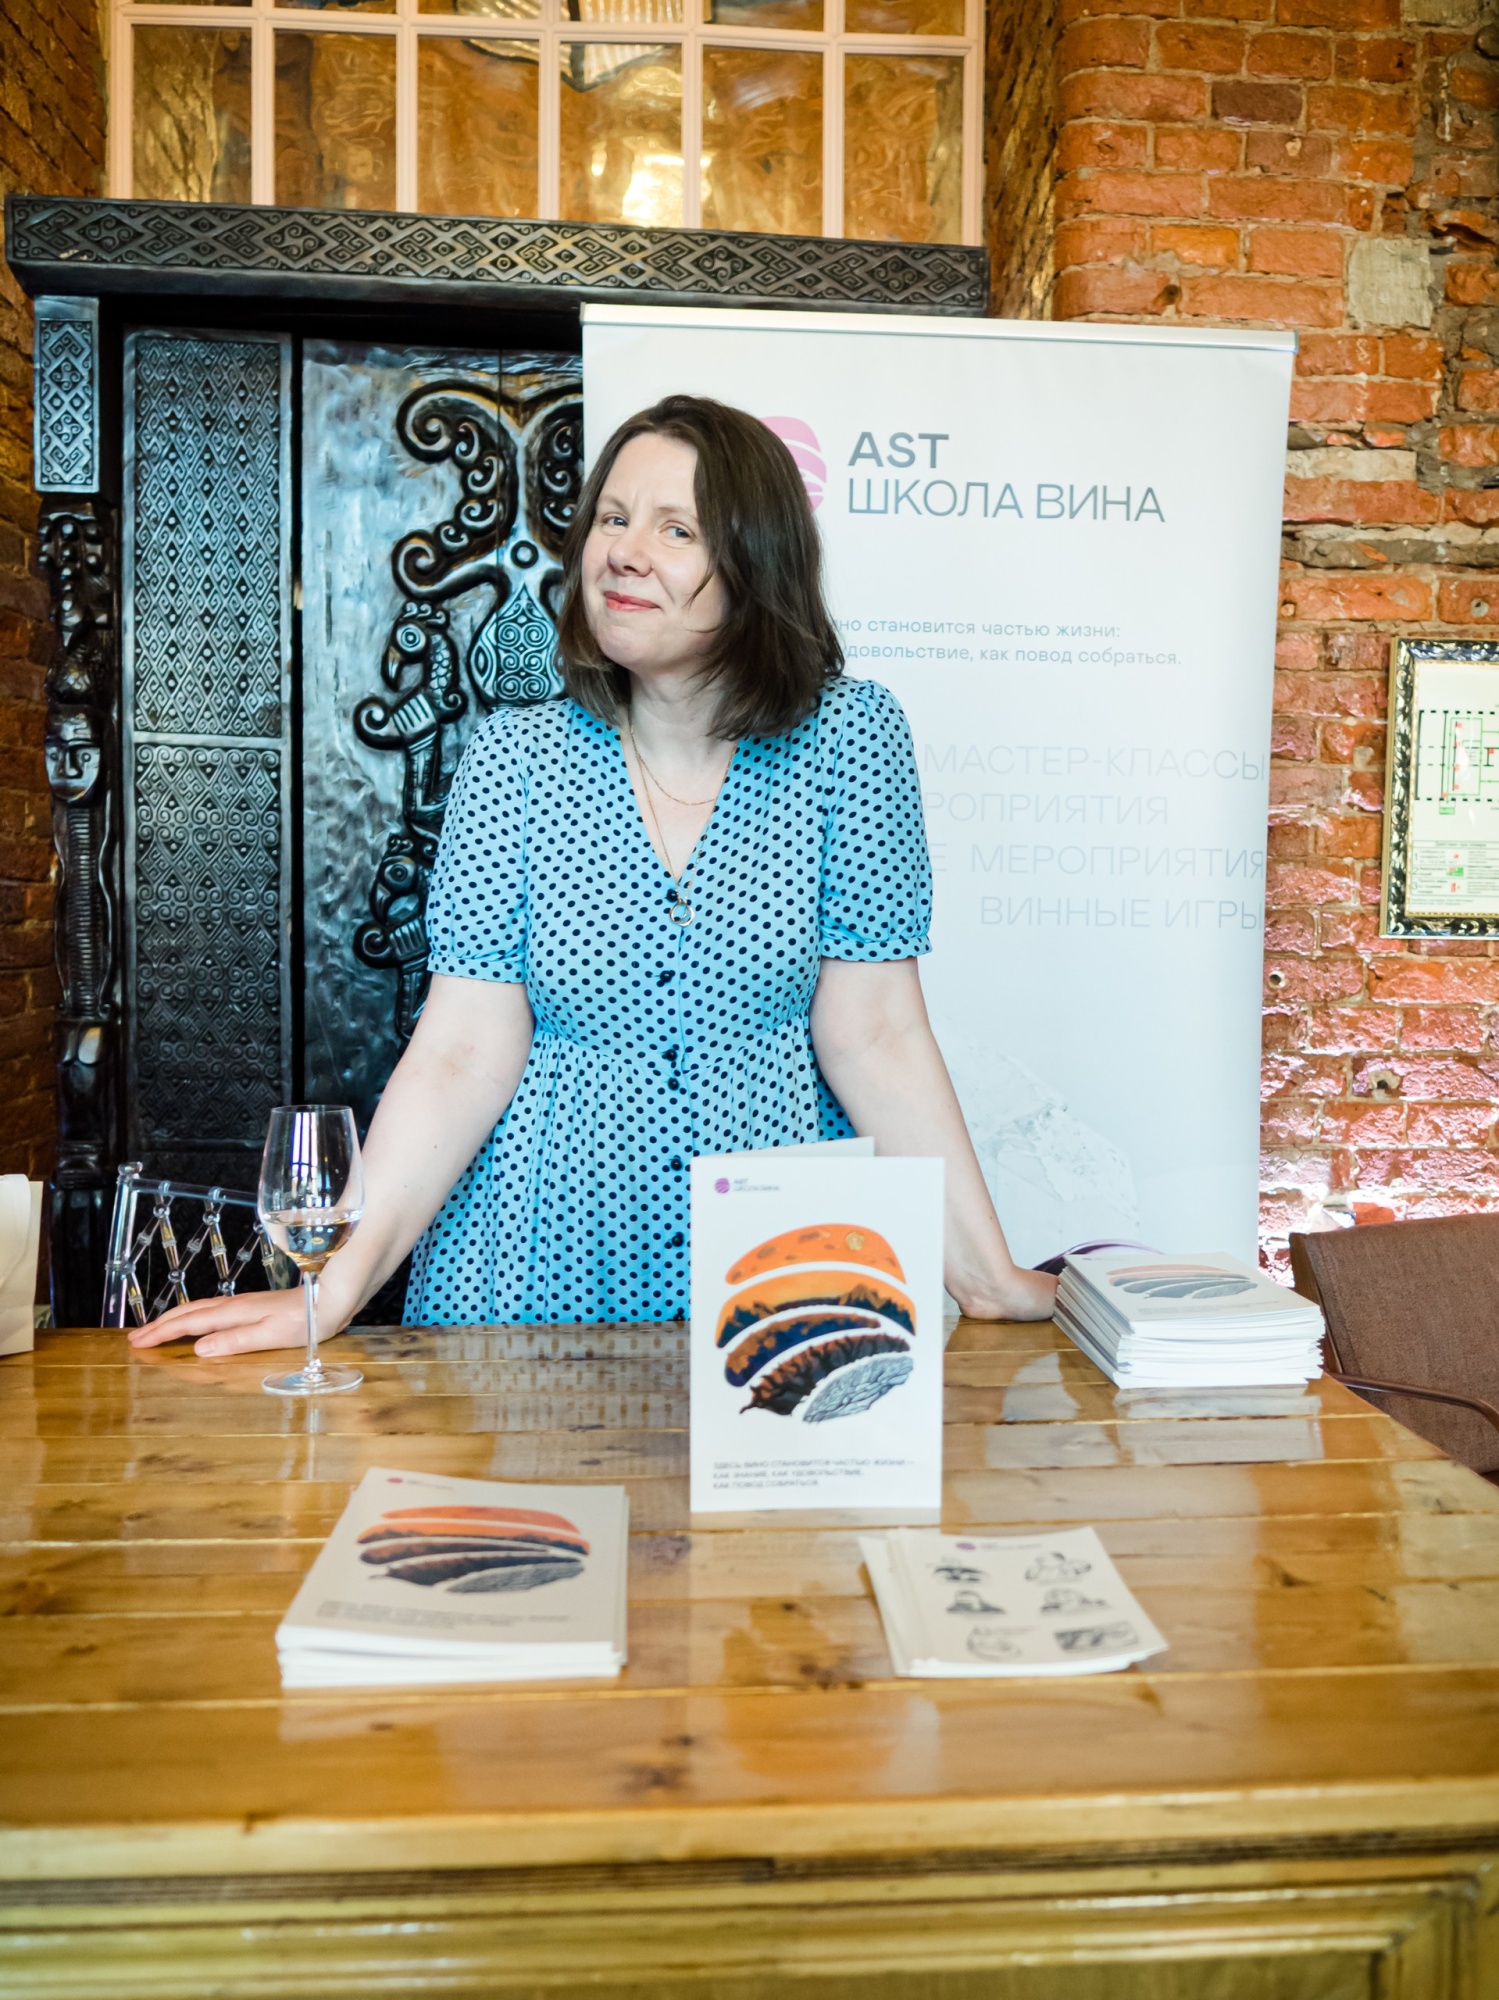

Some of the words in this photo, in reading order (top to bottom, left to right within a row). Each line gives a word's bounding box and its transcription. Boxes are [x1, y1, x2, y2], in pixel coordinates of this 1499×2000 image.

[847, 431, 950, 469] AST
[848, 477, 1024, 519] ШКОЛА
[1035, 482, 1166, 523] ВИНА
[837, 619, 862, 632] но
[867, 620, 976, 635] становится
[981, 622, 1051, 637] частью
[1055, 624, 1121, 638] жизни:
[846, 644, 974, 662] довольствие,
[979, 648, 1009, 661] как
[1014, 649, 1073, 665] повод
[1077, 646, 1182, 667] собраться.
[923, 743, 1265, 781] МАСТЕР-КЛАССЫ
[924, 792, 1169, 825] РОПРИЯТИЯ
[970, 843, 1264, 878] МЕРОПРИЯТИЯ
[980, 895, 1151, 928] ВИННЫЕ
[1164, 898, 1262, 930] ИГРЫ
